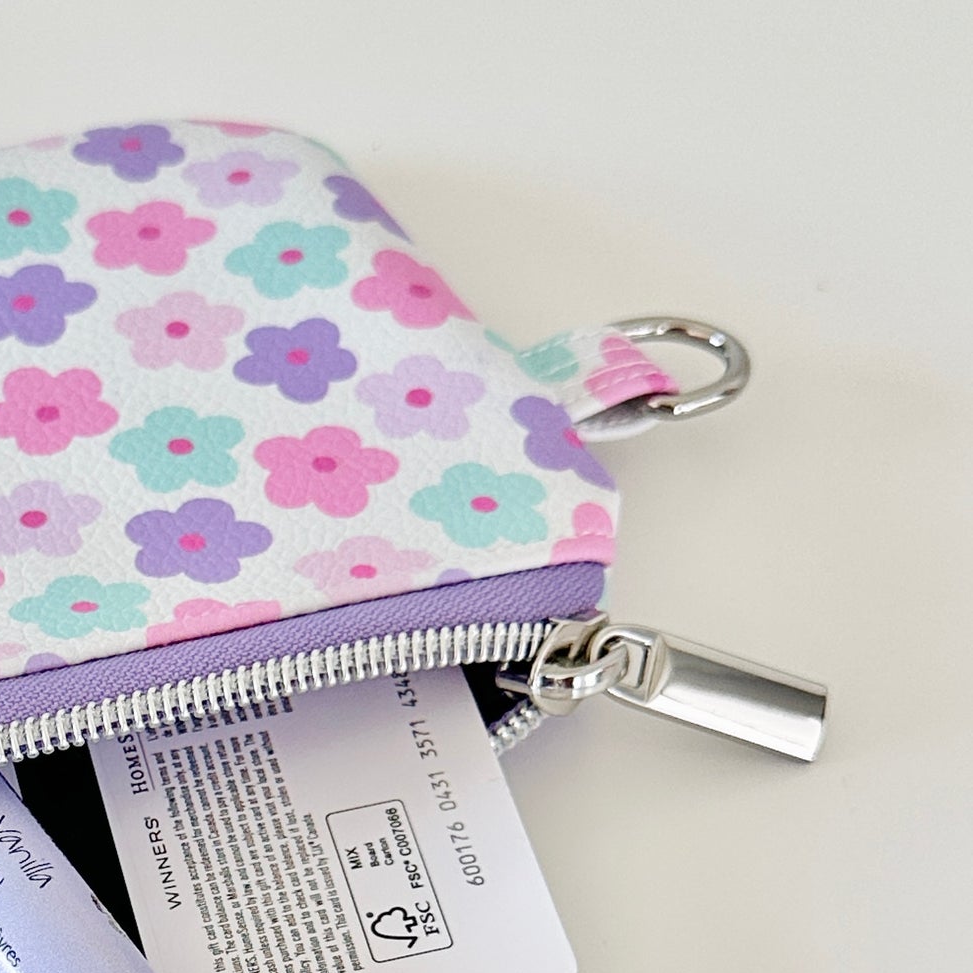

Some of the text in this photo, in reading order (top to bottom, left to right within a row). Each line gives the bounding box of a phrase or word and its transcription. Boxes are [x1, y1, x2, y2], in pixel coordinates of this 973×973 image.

[229, 736, 241, 754] more
[243, 733, 255, 747] The
[257, 730, 274, 756] without
[408, 719, 438, 759] 3571
[169, 748, 180, 761] any
[213, 738, 228, 760] return
[151, 751, 166, 765] and
[171, 761, 183, 769] at
[181, 745, 201, 778] redeemed
[233, 754, 245, 766] For
[266, 757, 281, 774] used
[157, 765, 171, 786] terms
[220, 760, 234, 778] store
[253, 767, 268, 785] local
[193, 778, 204, 788] be
[206, 771, 222, 791] credit
[274, 776, 285, 784] or
[225, 778, 246, 813] applicable
[244, 784, 256, 796] any
[260, 785, 275, 800] your
[276, 785, 292, 808] stolen
[427, 770, 457, 812] 0431
[164, 785, 180, 818] following
[179, 784, 199, 827] merchandise
[195, 787, 212, 811] cannot
[216, 796, 229, 809] pay
[247, 797, 259, 805] at
[218, 808, 229, 817] to
[249, 805, 264, 821] card
[264, 801, 278, 817] visit
[172, 819, 185, 832] the
[218, 816, 235, 834] used
[236, 813, 247, 822] to
[174, 832, 188, 841] of
[191, 827, 203, 839] for
[238, 822, 256, 849] subject
[256, 822, 271, 843] active
[271, 817, 288, 840] please
[212, 839, 222, 847] in
[226, 834, 238, 844] be
[193, 837, 213, 872] redeemed
[228, 843, 245, 868] cannot
[248, 849, 260, 860] are
[263, 843, 274, 853] an
[290, 834, 311, 865] replaced
[363, 841, 380, 868] Board
[378, 837, 394, 866] Carton
[446, 821, 485, 886] 600176
[180, 841, 200, 881] acceptance
[214, 847, 228, 866] store
[262, 854, 277, 862] of
[316, 857, 329, 867] by
[345, 846, 363, 870] MIX
[204, 871, 217, 883] be
[235, 867, 249, 881] and
[249, 861, 265, 877] card
[268, 862, 285, 891] balance
[303, 867, 314, 877] be
[218, 865, 238, 901] Marshalls
[254, 878, 272, 892] gift
[285, 871, 301, 887] card
[305, 878, 319, 891] not
[317, 865, 335, 890] issued
[208, 881, 221, 895] can
[327, 889, 338, 897] is
[192, 882, 212, 923] constitutes
[230, 900, 241, 909] or
[245, 896, 257, 906] by
[261, 891, 274, 907] this
[276, 891, 290, 904] the
[291, 888, 308, 910] check
[309, 893, 324, 906] will
[327, 896, 343, 913] card
[212, 895, 229, 924] balance
[264, 907, 279, 924] with
[281, 904, 292, 913] to
[300, 910, 311, 920] to
[315, 908, 330, 925] card
[246, 905, 266, 935] required
[282, 912, 297, 927] add
[334, 912, 348, 930] This
[414, 900, 440, 936] FSC
[202, 924, 217, 941] card
[218, 923, 234, 940] card
[289, 928, 302, 942] can
[301, 920, 317, 934] and
[322, 926, 336, 943] this
[207, 941, 224, 956] gift
[224, 939, 237, 955] The
[258, 934, 274, 959] unless
[268, 924, 294, 963] purchased
[293, 942, 306, 957] You
[325, 944, 340, 953] of
[213, 956, 226, 973] this
